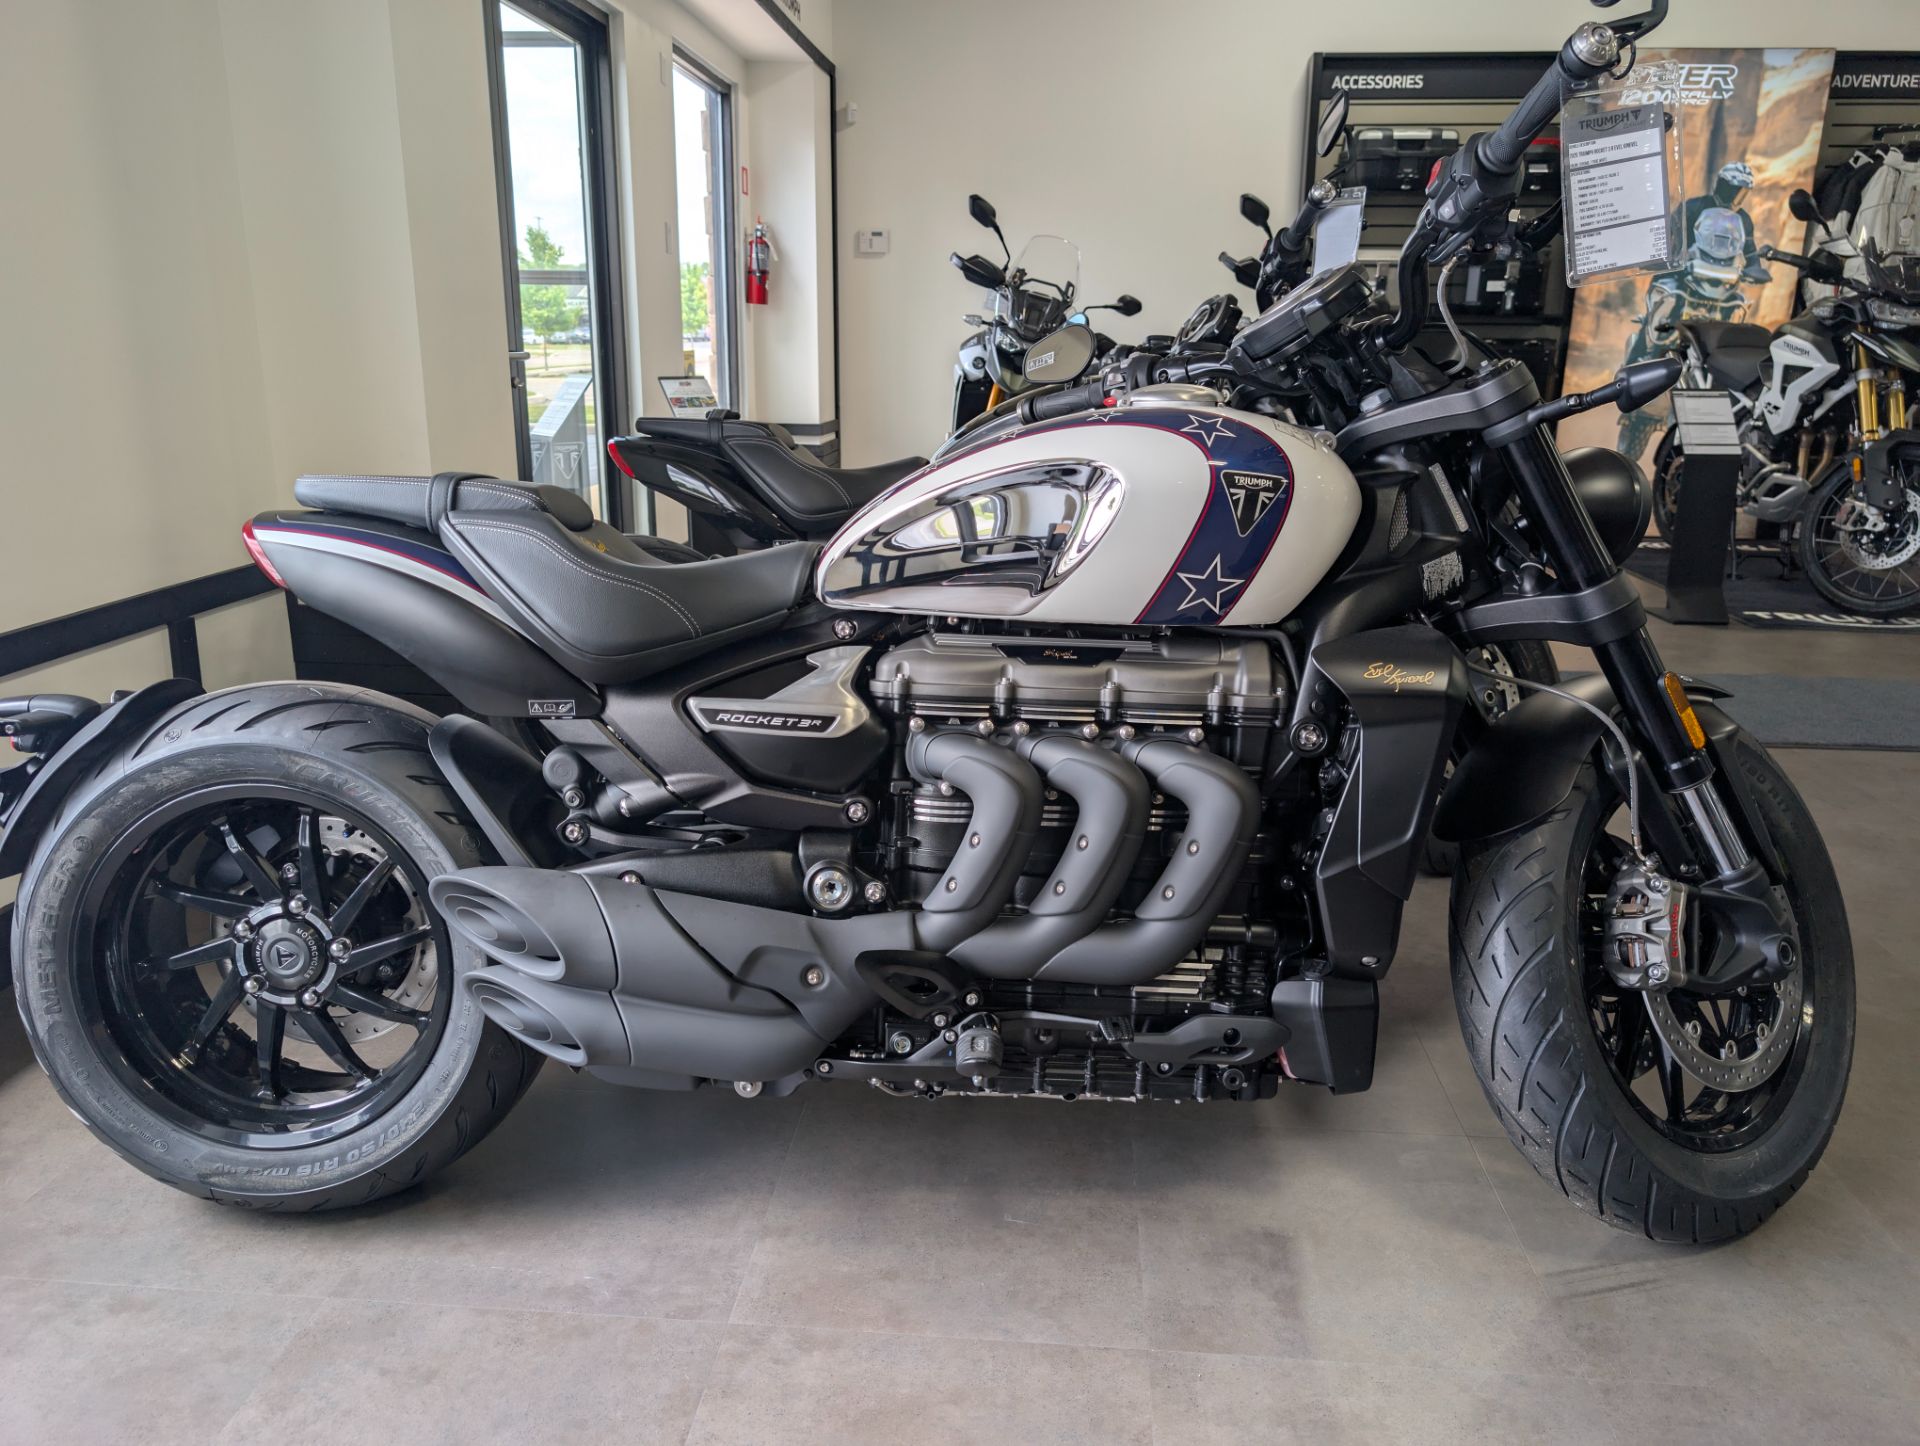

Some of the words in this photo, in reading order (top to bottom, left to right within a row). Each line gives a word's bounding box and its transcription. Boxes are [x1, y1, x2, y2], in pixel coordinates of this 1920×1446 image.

[1331, 74, 1424, 89] ACCESSORIES
[1831, 74, 1920, 88] ADVENTURE
[1579, 111, 1630, 131] TRIUMPH
[1783, 341, 1811, 356] TRIUMPH
[1234, 475, 1273, 489] TRIUMPH
[36, 857, 80, 1016] METZELER
[255, 939, 268, 977] TRIUMPH
[296, 927, 319, 979] MOTORCYCLES
